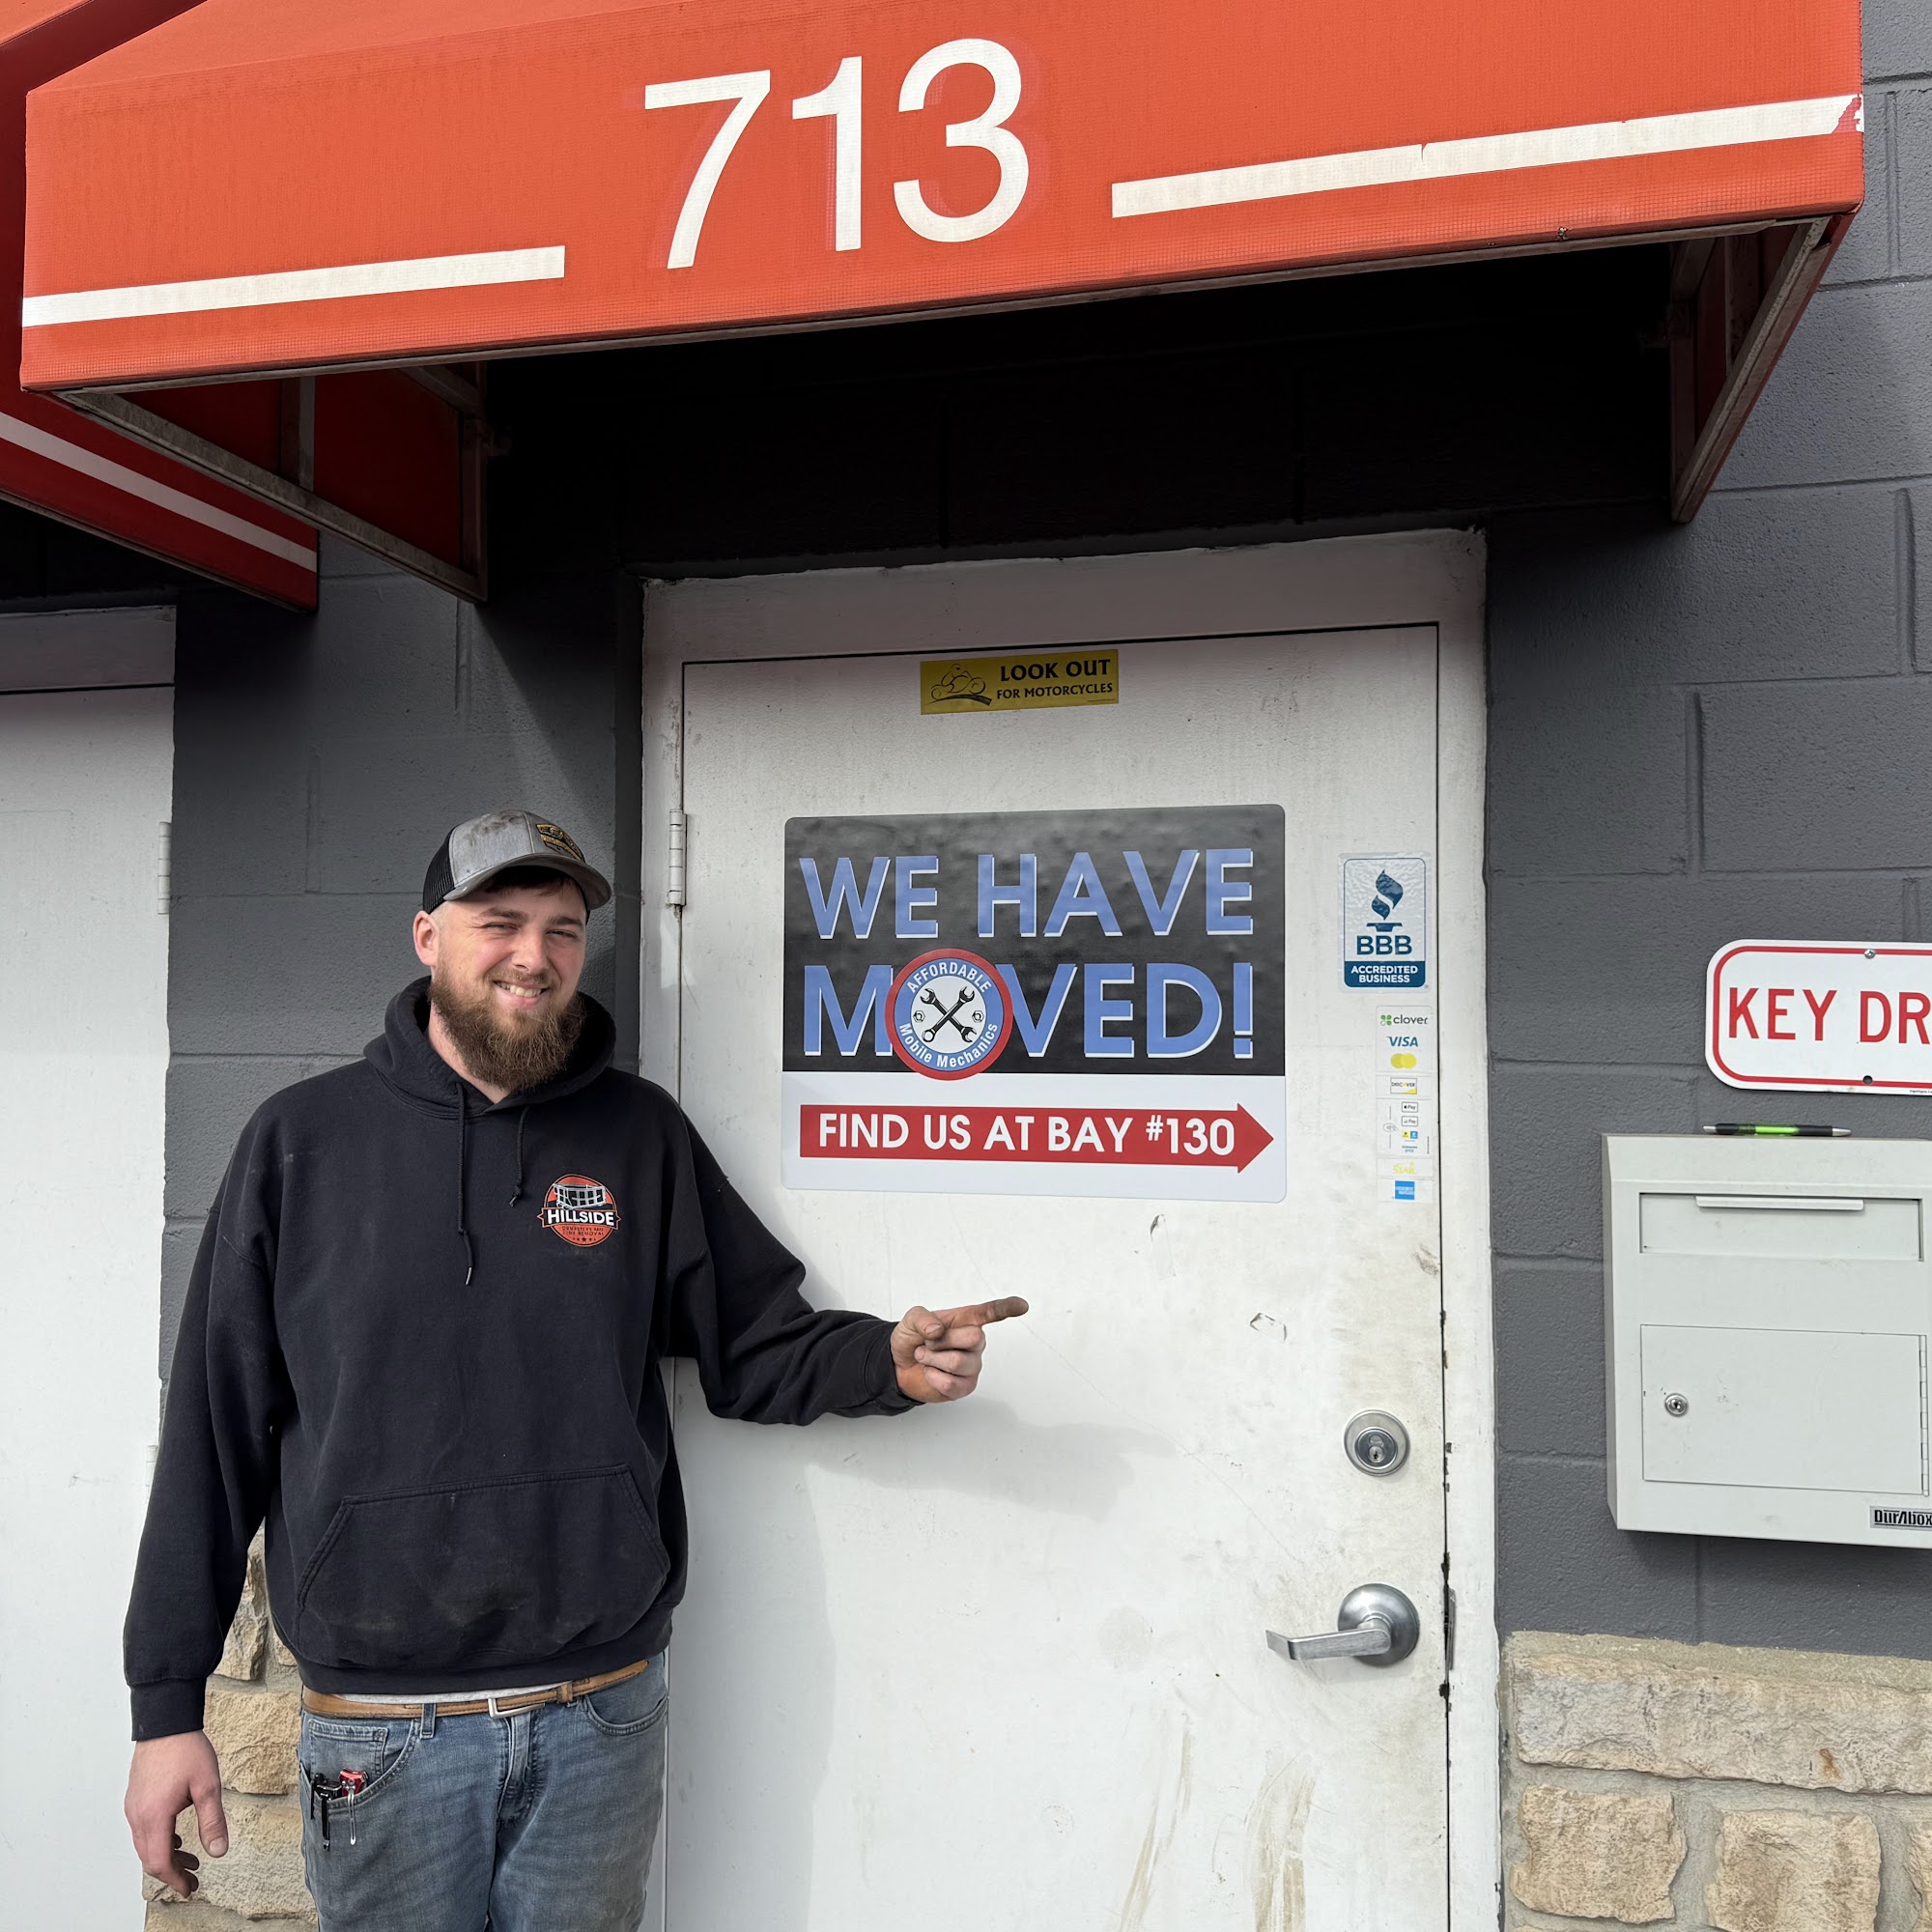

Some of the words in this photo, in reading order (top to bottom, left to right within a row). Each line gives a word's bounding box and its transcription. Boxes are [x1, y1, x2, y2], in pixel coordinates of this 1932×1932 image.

[644, 38, 1030, 270] 713
[1000, 663, 1059, 682] LOOK
[1065, 659, 1111, 677] OUT
[997, 687, 1020, 699] FOR
[1024, 682, 1113, 697] MOTORCYCLES
[799, 855, 939, 940] WE
[978, 848, 1254, 938] HAVE
[1356, 935, 1412, 955] BBB
[906, 961, 992, 994] AFFORDABLE
[1350, 965, 1418, 974] ACCREDITED
[1358, 974, 1410, 983] BUSINESS
[804, 961, 1254, 1059] MOVED!
[1393, 1014, 1428, 1025] clover
[1728, 986, 1837, 1041] KEY
[1860, 990, 1931, 1045] DR
[899, 1022, 933, 1064] Mobile
[936, 1023, 998, 1068] Mechanics
[1386, 1036, 1419, 1047] VISA
[819, 1113, 909, 1149] FIND
[923, 1116, 972, 1151] US
[983, 1116, 1035, 1151] AT
[1048, 1117, 1134, 1152] BAY
[1146, 1115, 1236, 1156] #130
[547, 1208, 615, 1227] HILLSIDE
